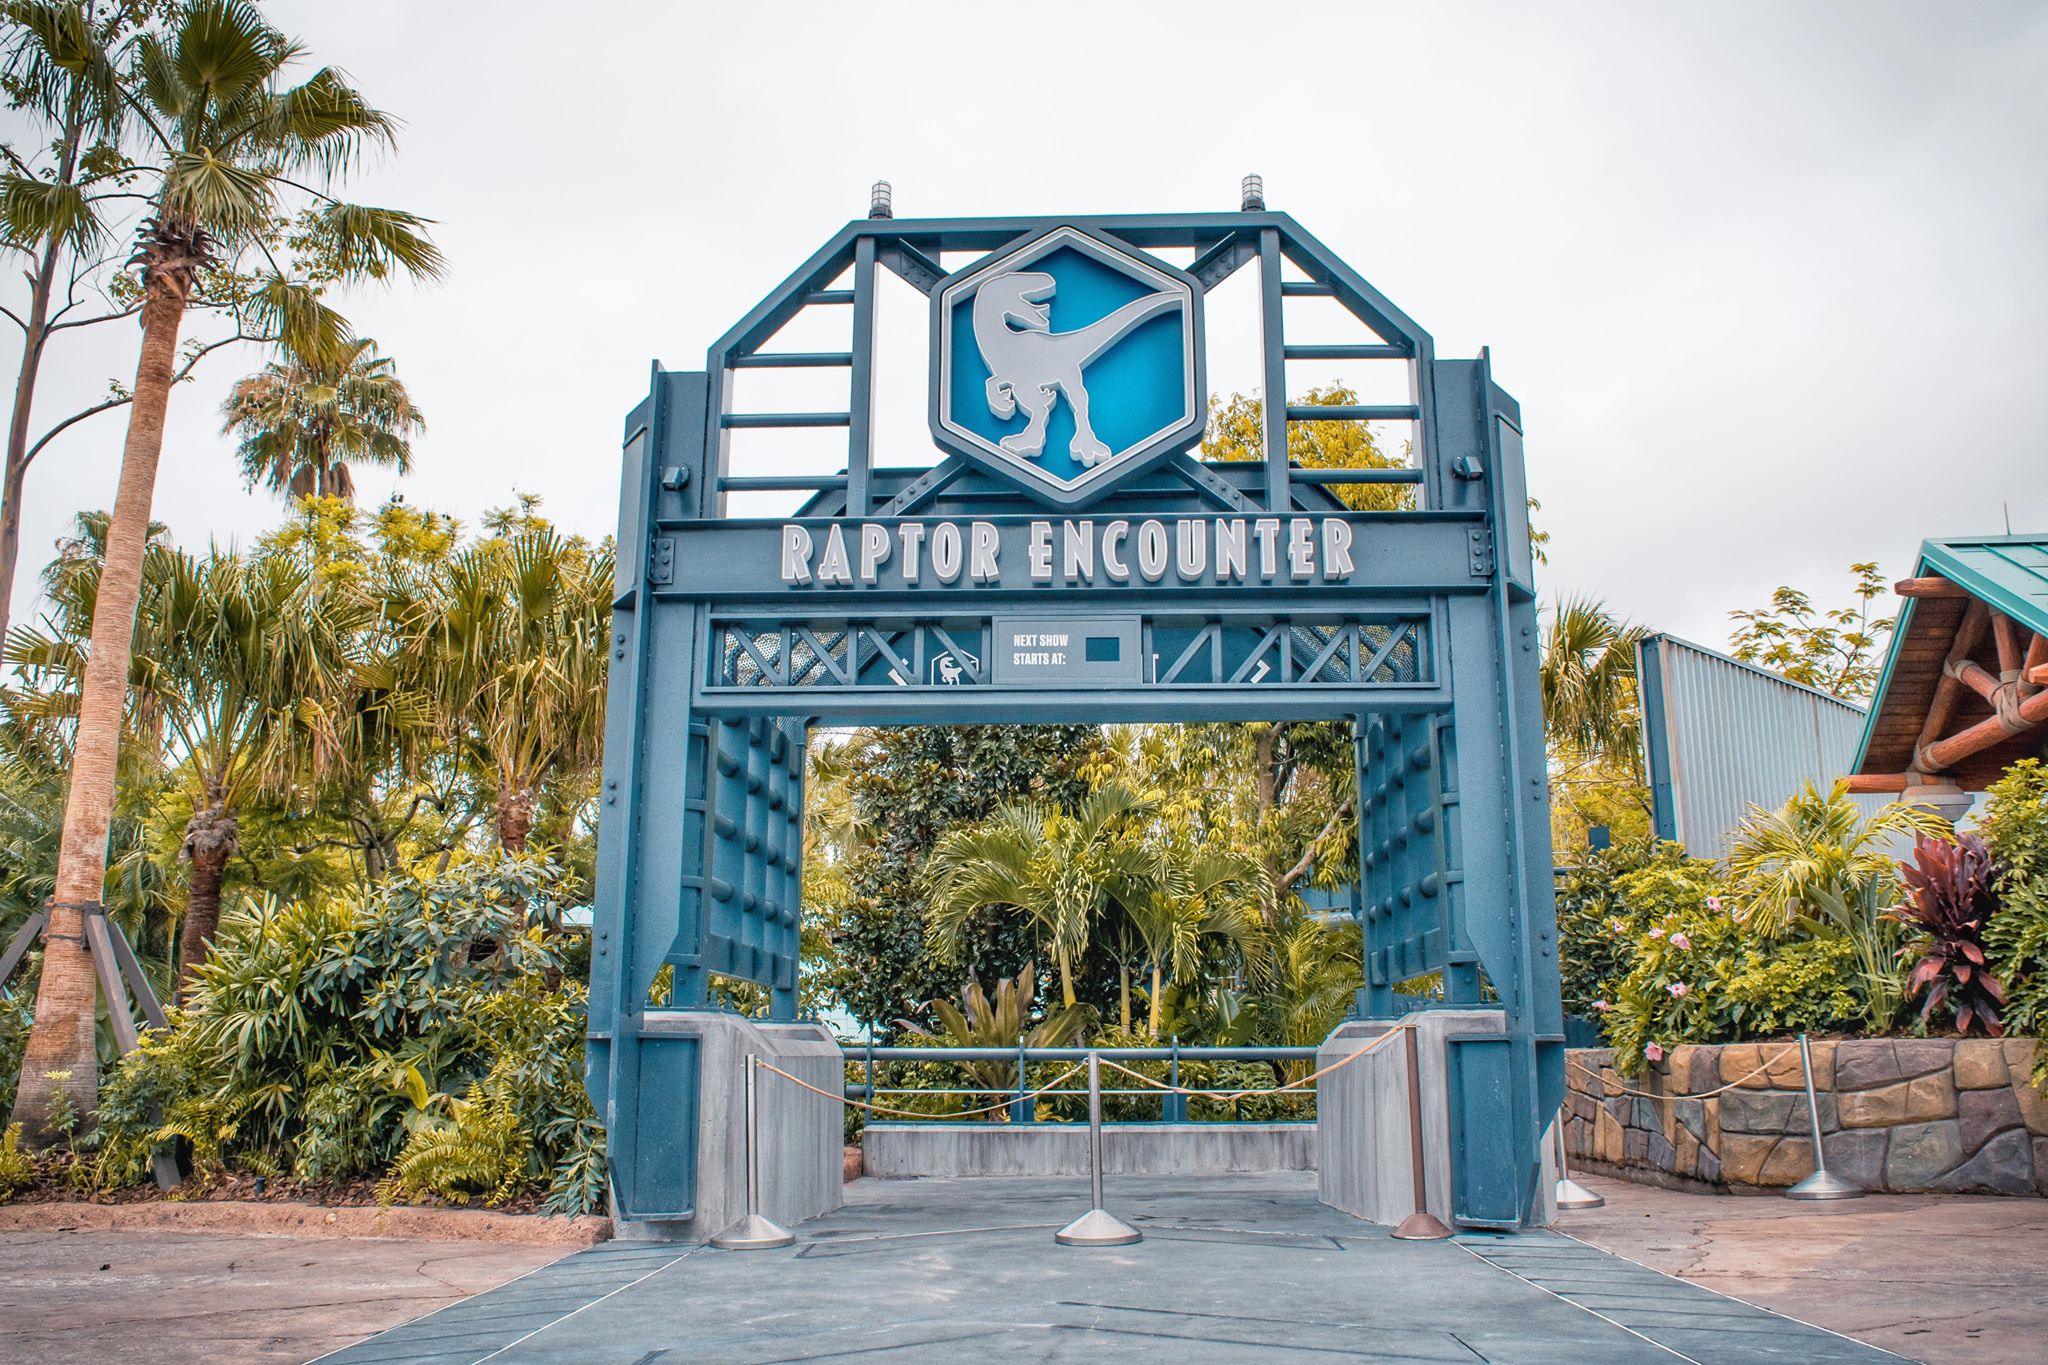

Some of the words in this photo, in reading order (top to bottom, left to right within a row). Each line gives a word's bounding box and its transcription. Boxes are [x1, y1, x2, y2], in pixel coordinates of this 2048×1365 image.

[781, 521, 1000, 586] RAPTOR
[1028, 518, 1355, 583] ENCOUNTER
[1013, 634, 1038, 647] NEXT
[1039, 634, 1069, 647] SHOW
[1013, 652, 1050, 666] STARTS
[1051, 652, 1067, 666] AT:
